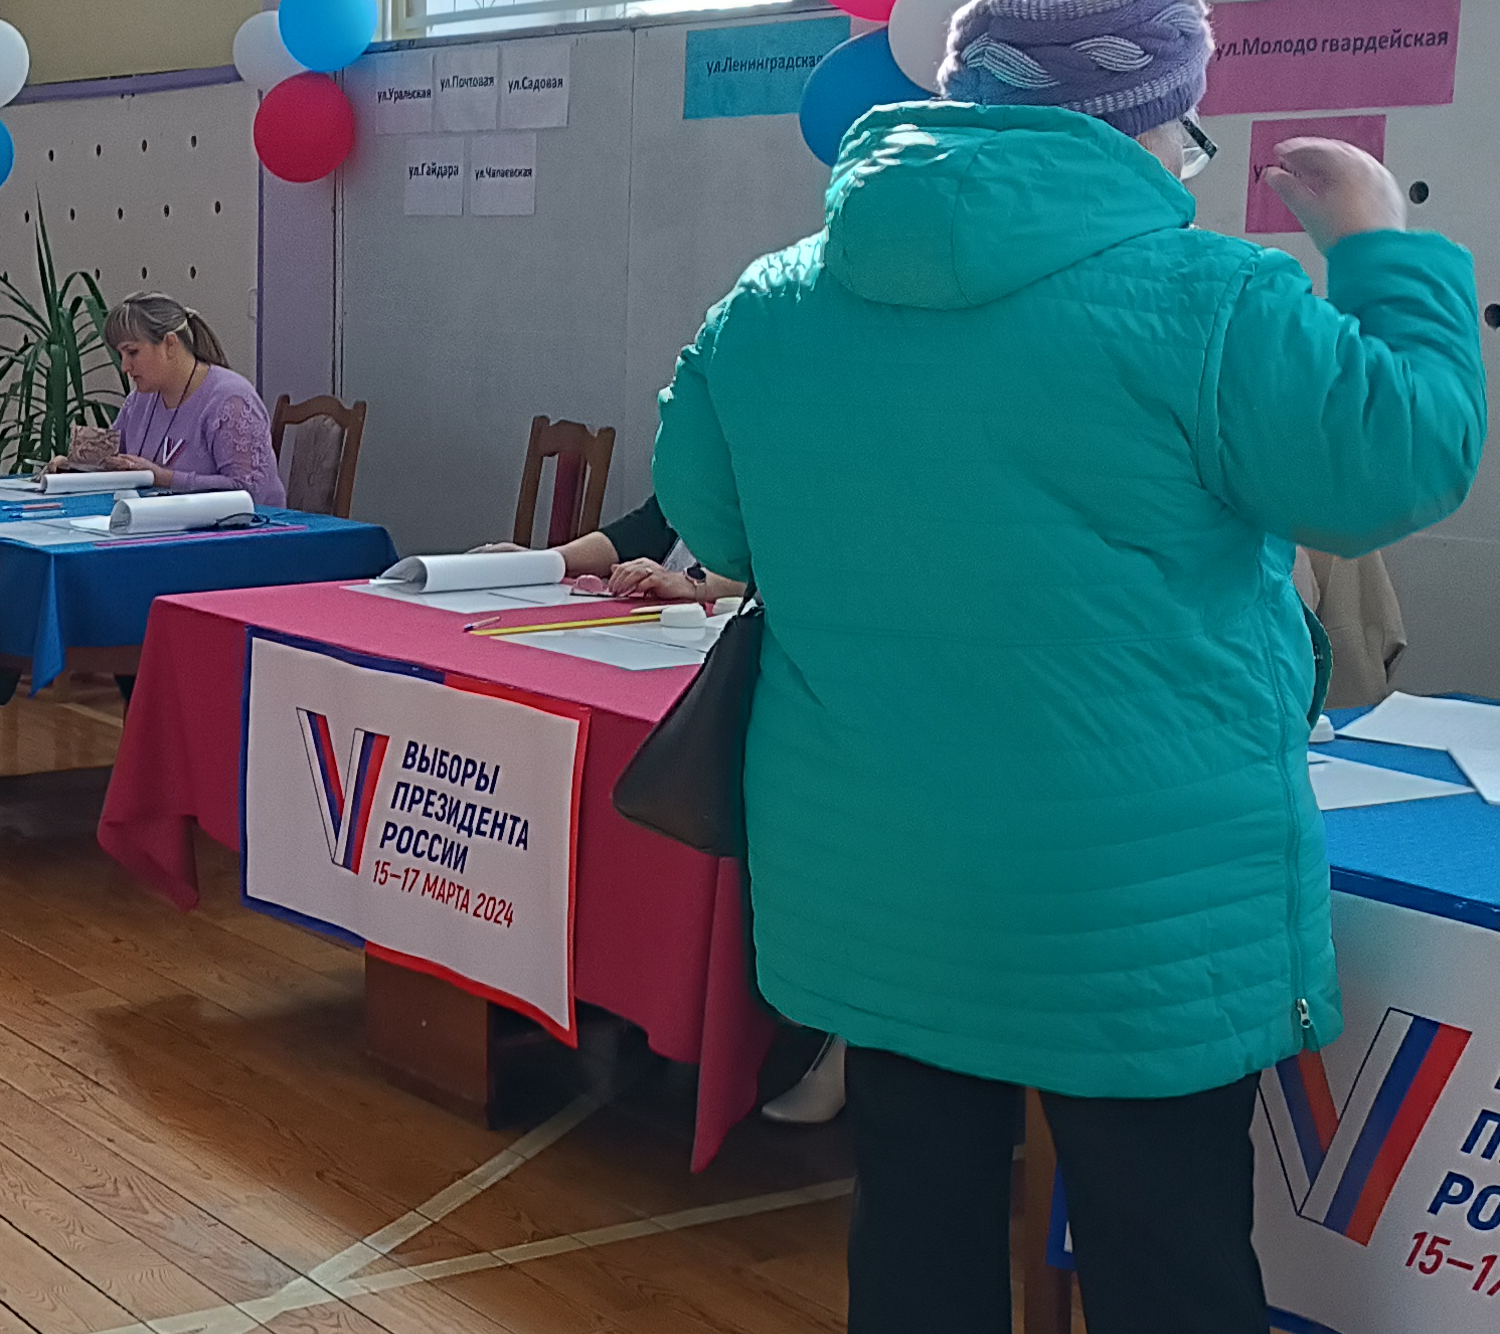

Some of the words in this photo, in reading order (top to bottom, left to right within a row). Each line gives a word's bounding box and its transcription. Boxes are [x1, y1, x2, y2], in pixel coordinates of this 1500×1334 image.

[1321, 28, 1449, 55] гвардейская
[377, 87, 432, 103] ул.Уральская
[440, 74, 495, 92] ул.Почтовая
[508, 75, 563, 93] ул.Садовая
[408, 162, 459, 180] ул.Гайдара
[402, 740, 500, 795] ВЫБОРЫ
[390, 781, 530, 851] ПРЕЗИДЕНТА
[379, 821, 469, 874] РОССИИ
[373, 860, 420, 893] 15–17
[420, 873, 470, 914] МАРТА
[472, 892, 514, 928] 2024
